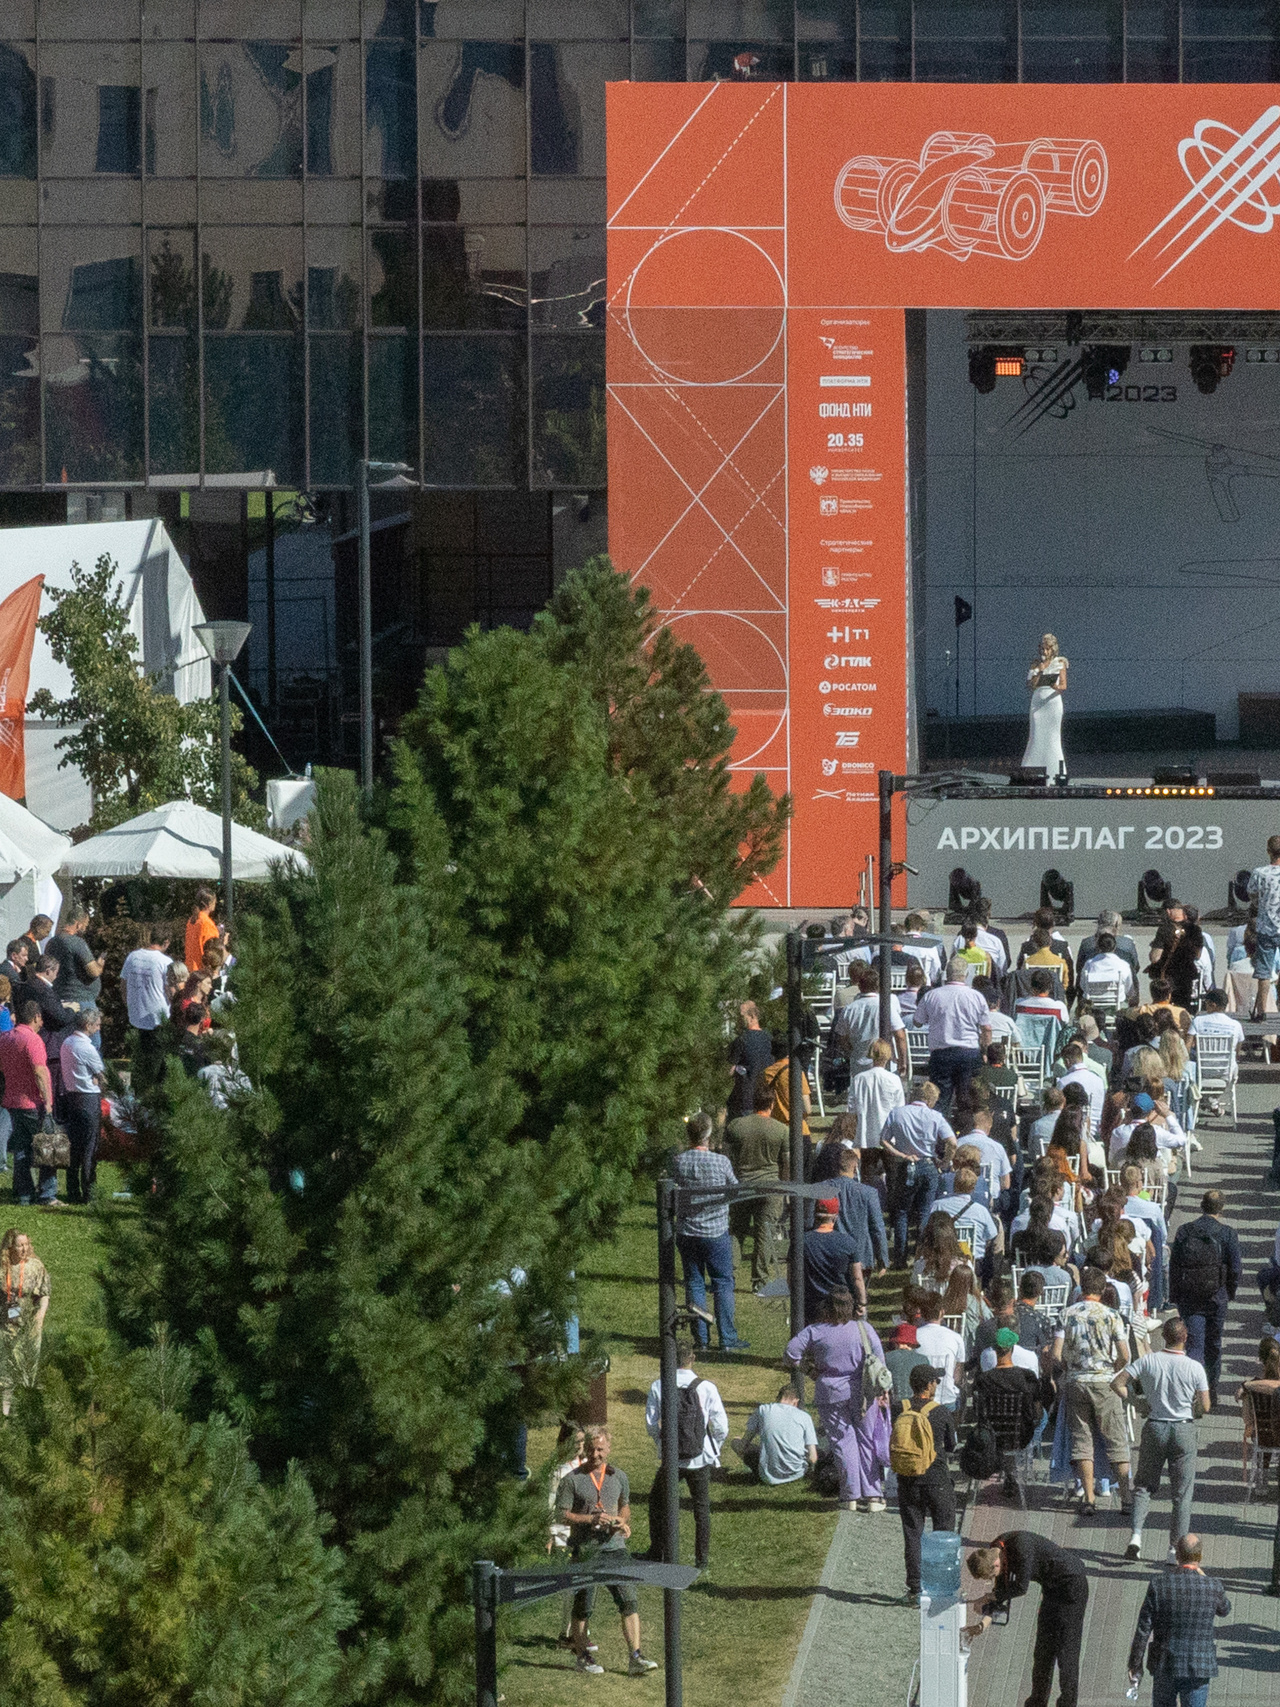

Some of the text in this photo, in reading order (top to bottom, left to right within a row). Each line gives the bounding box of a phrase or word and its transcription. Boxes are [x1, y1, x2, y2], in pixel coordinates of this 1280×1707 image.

[819, 402, 872, 418] ФОНД НТИ
[827, 433, 864, 447] 20.35
[841, 656, 872, 667] ГТЛК
[832, 683, 877, 691] РОСАТОМ
[936, 826, 1224, 850] АРХИПЕЛАГ 2023
